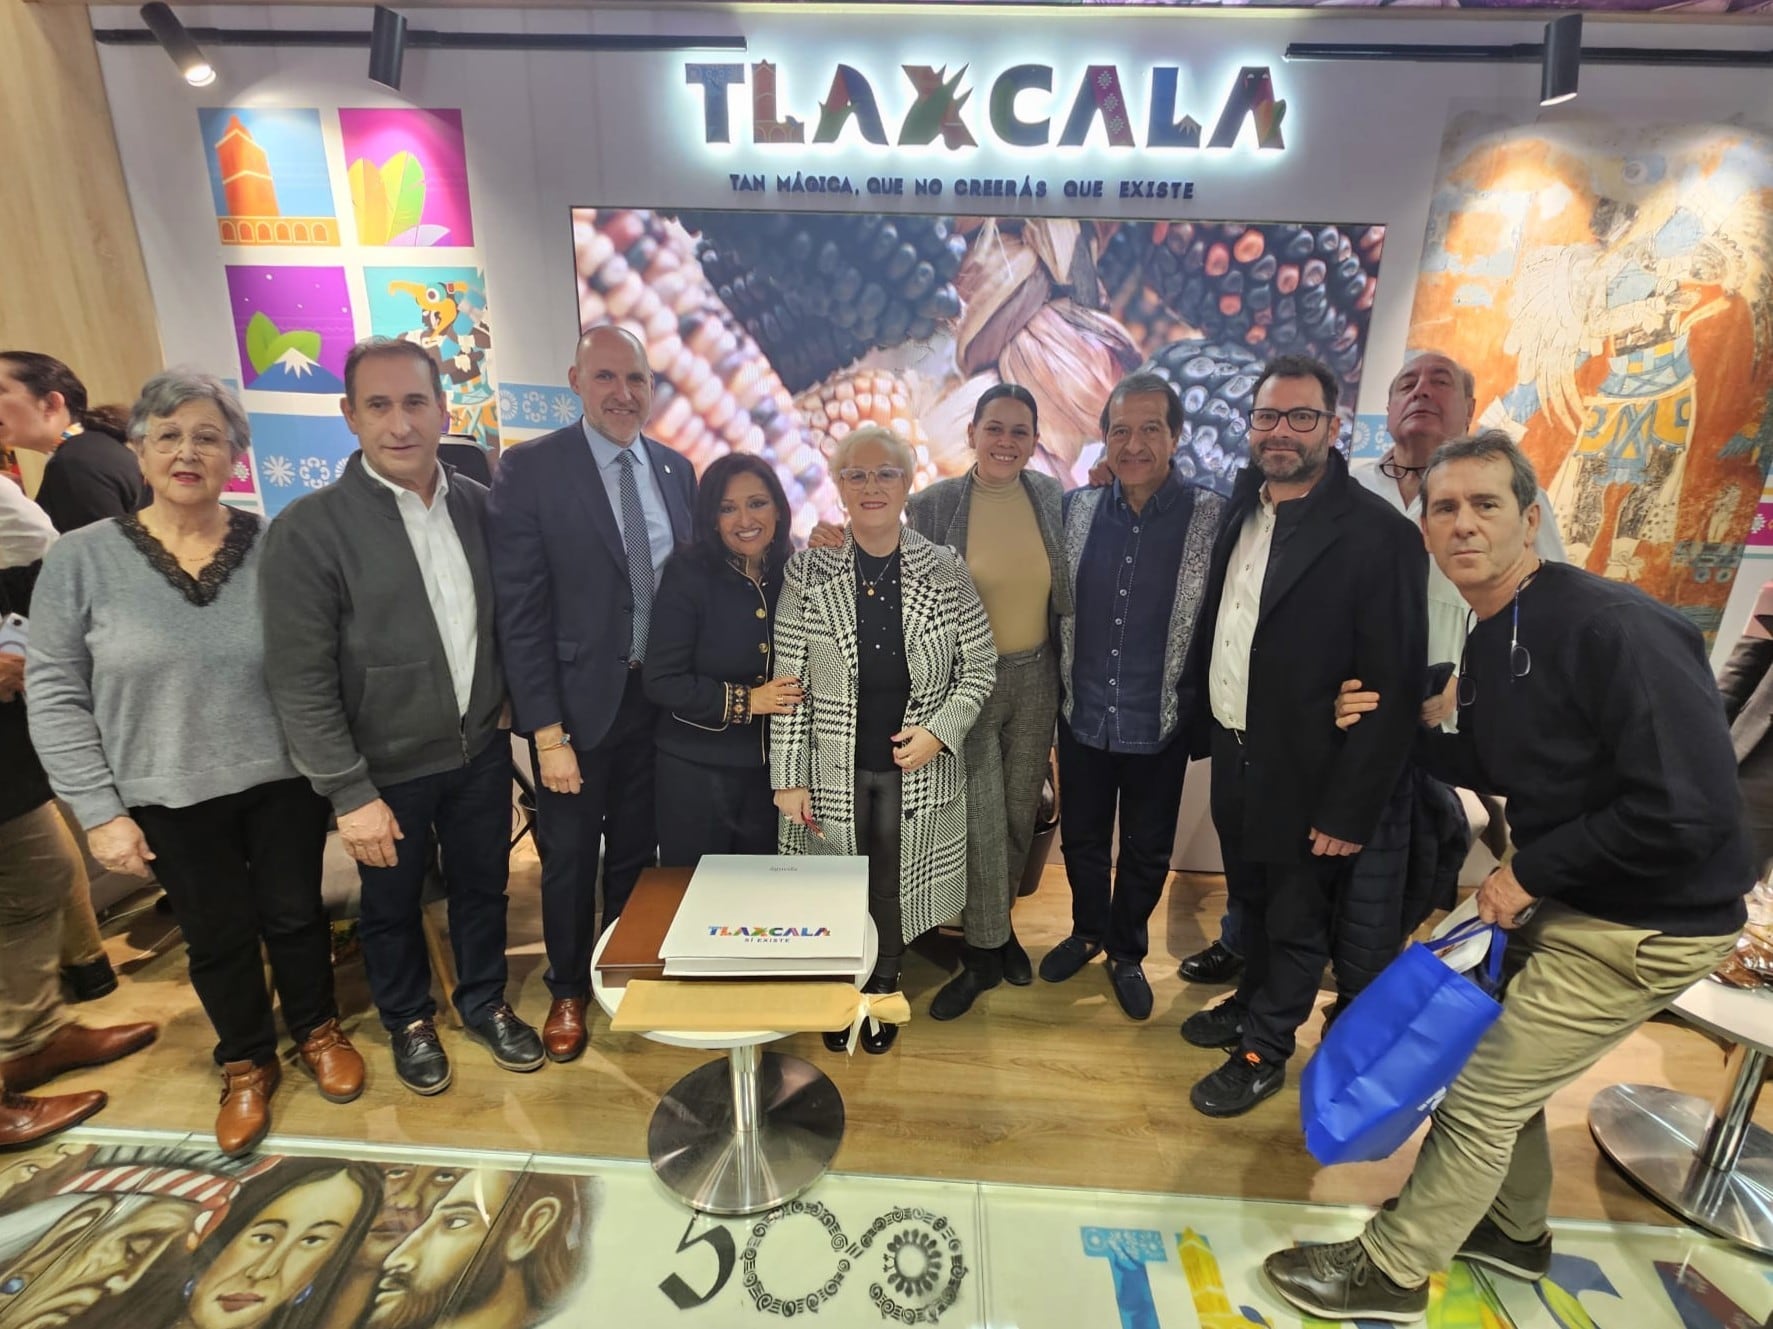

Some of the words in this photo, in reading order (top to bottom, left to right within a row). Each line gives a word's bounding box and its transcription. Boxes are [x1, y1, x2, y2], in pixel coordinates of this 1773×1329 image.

[686, 59, 1286, 150] TLAXCALA
[729, 174, 766, 192] TAN
[866, 176, 903, 195] QUE
[915, 178, 943, 196] NO
[954, 175, 1047, 198] CREERÁS
[1063, 180, 1103, 198] QUE
[1119, 181, 1194, 199] EXISTE
[708, 926, 831, 937] TLAXCALA
